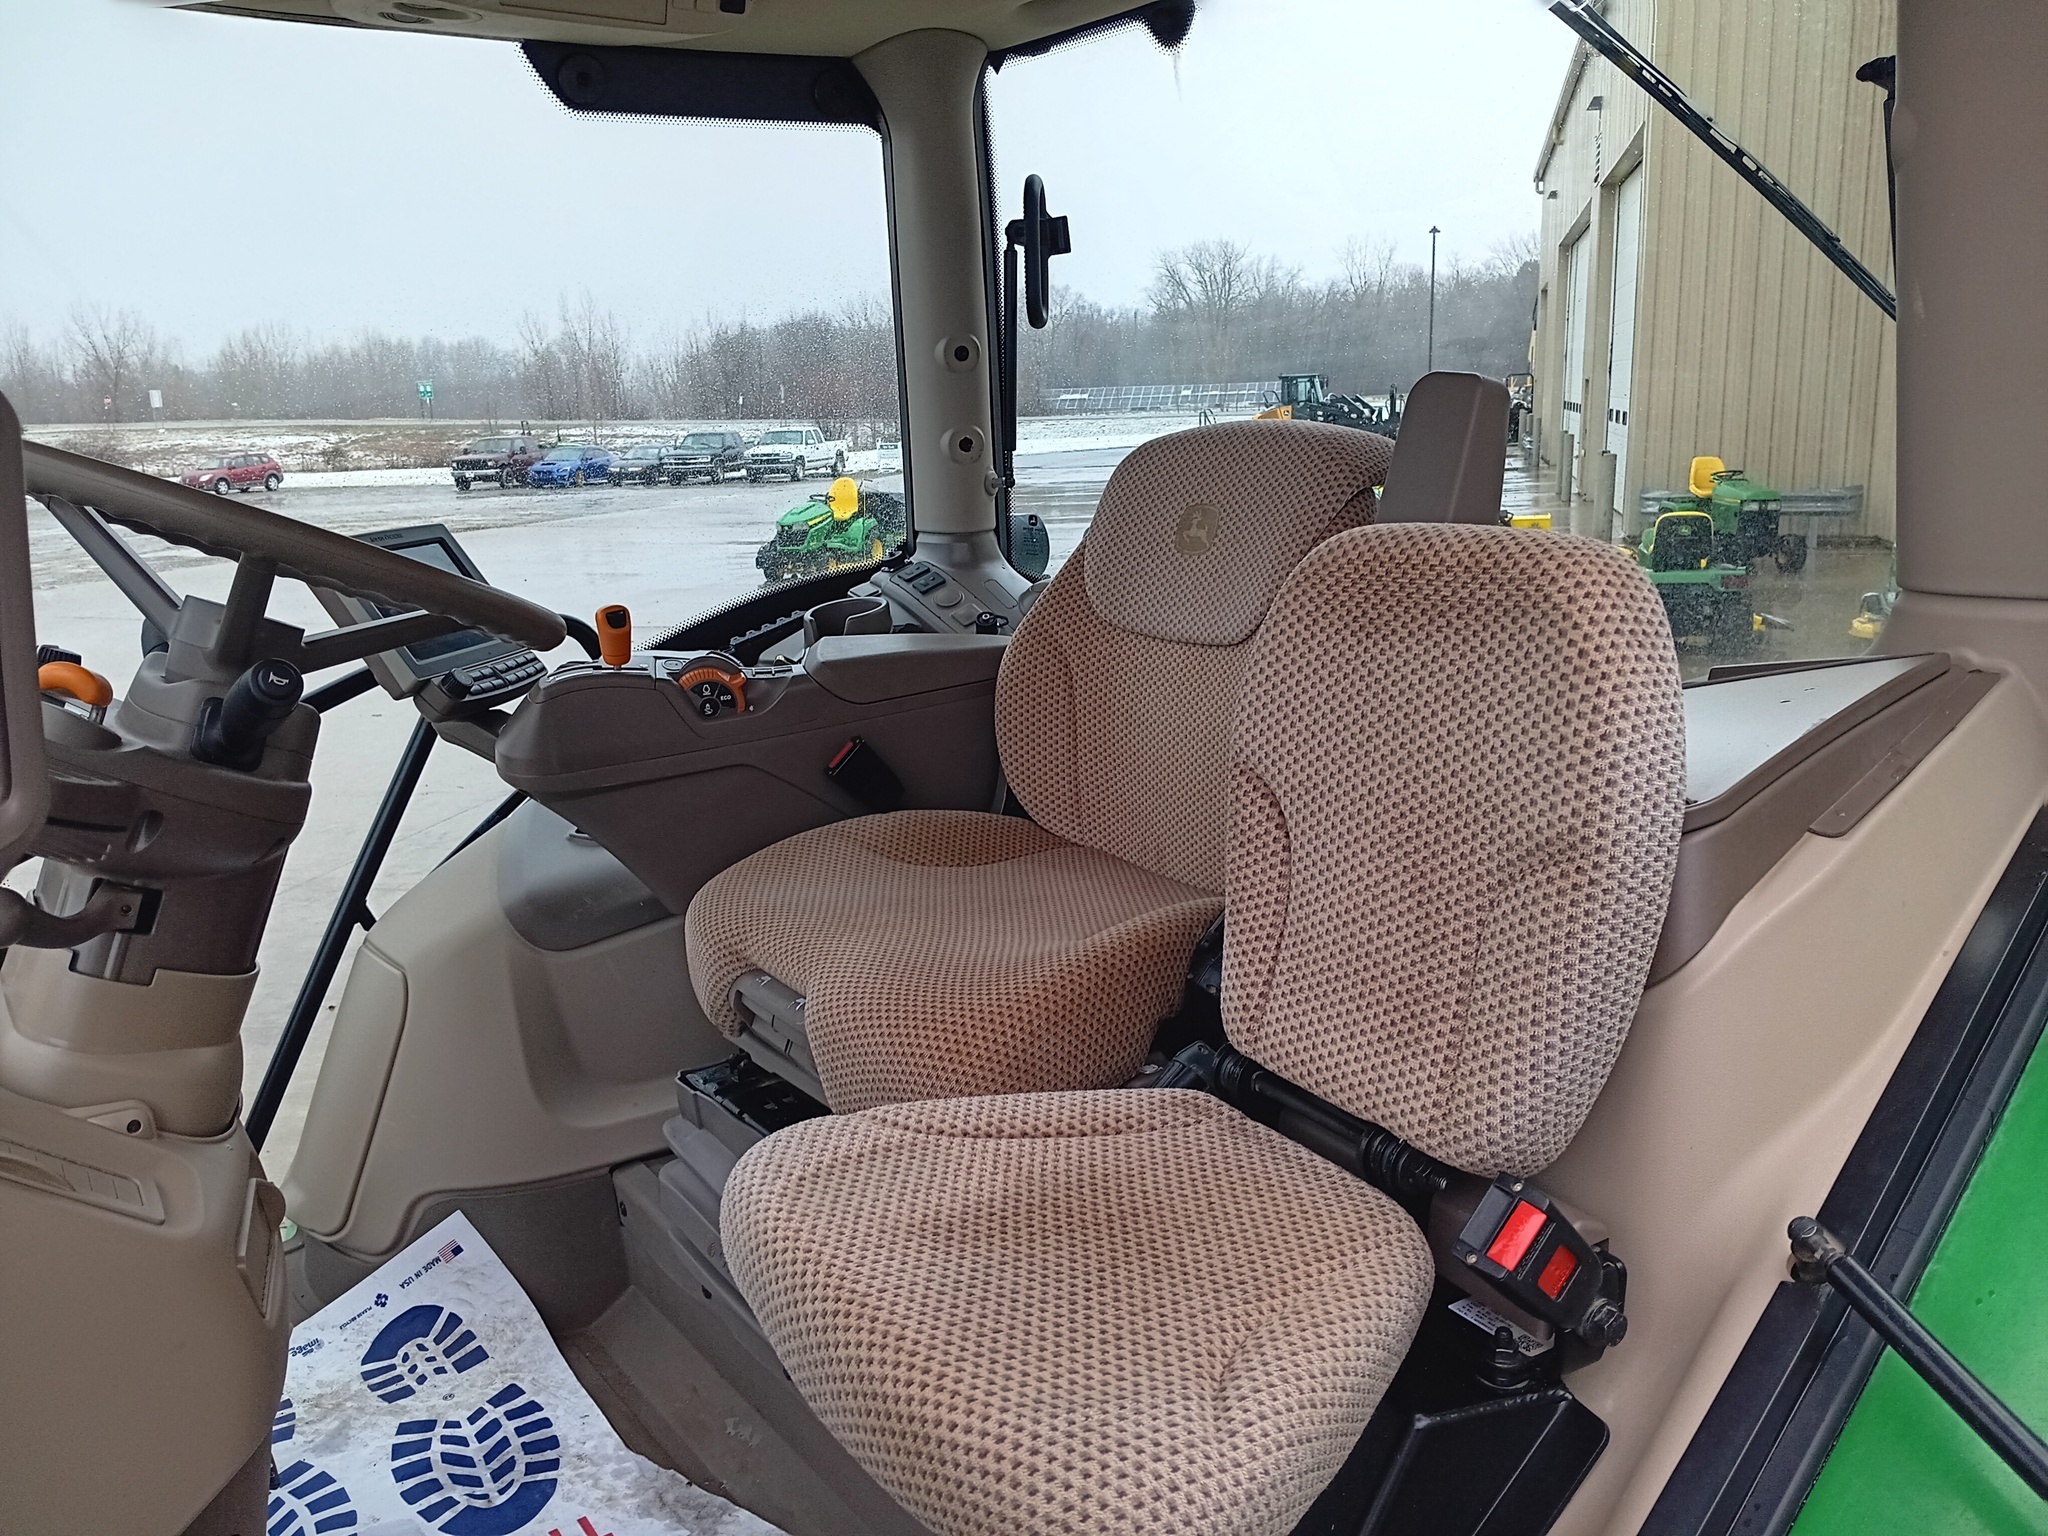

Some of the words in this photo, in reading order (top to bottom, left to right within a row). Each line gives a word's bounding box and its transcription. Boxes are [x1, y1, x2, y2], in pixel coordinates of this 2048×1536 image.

[422, 1256, 442, 1273] MADE
[414, 1270, 423, 1279] IN
[399, 1276, 415, 1289] USA
